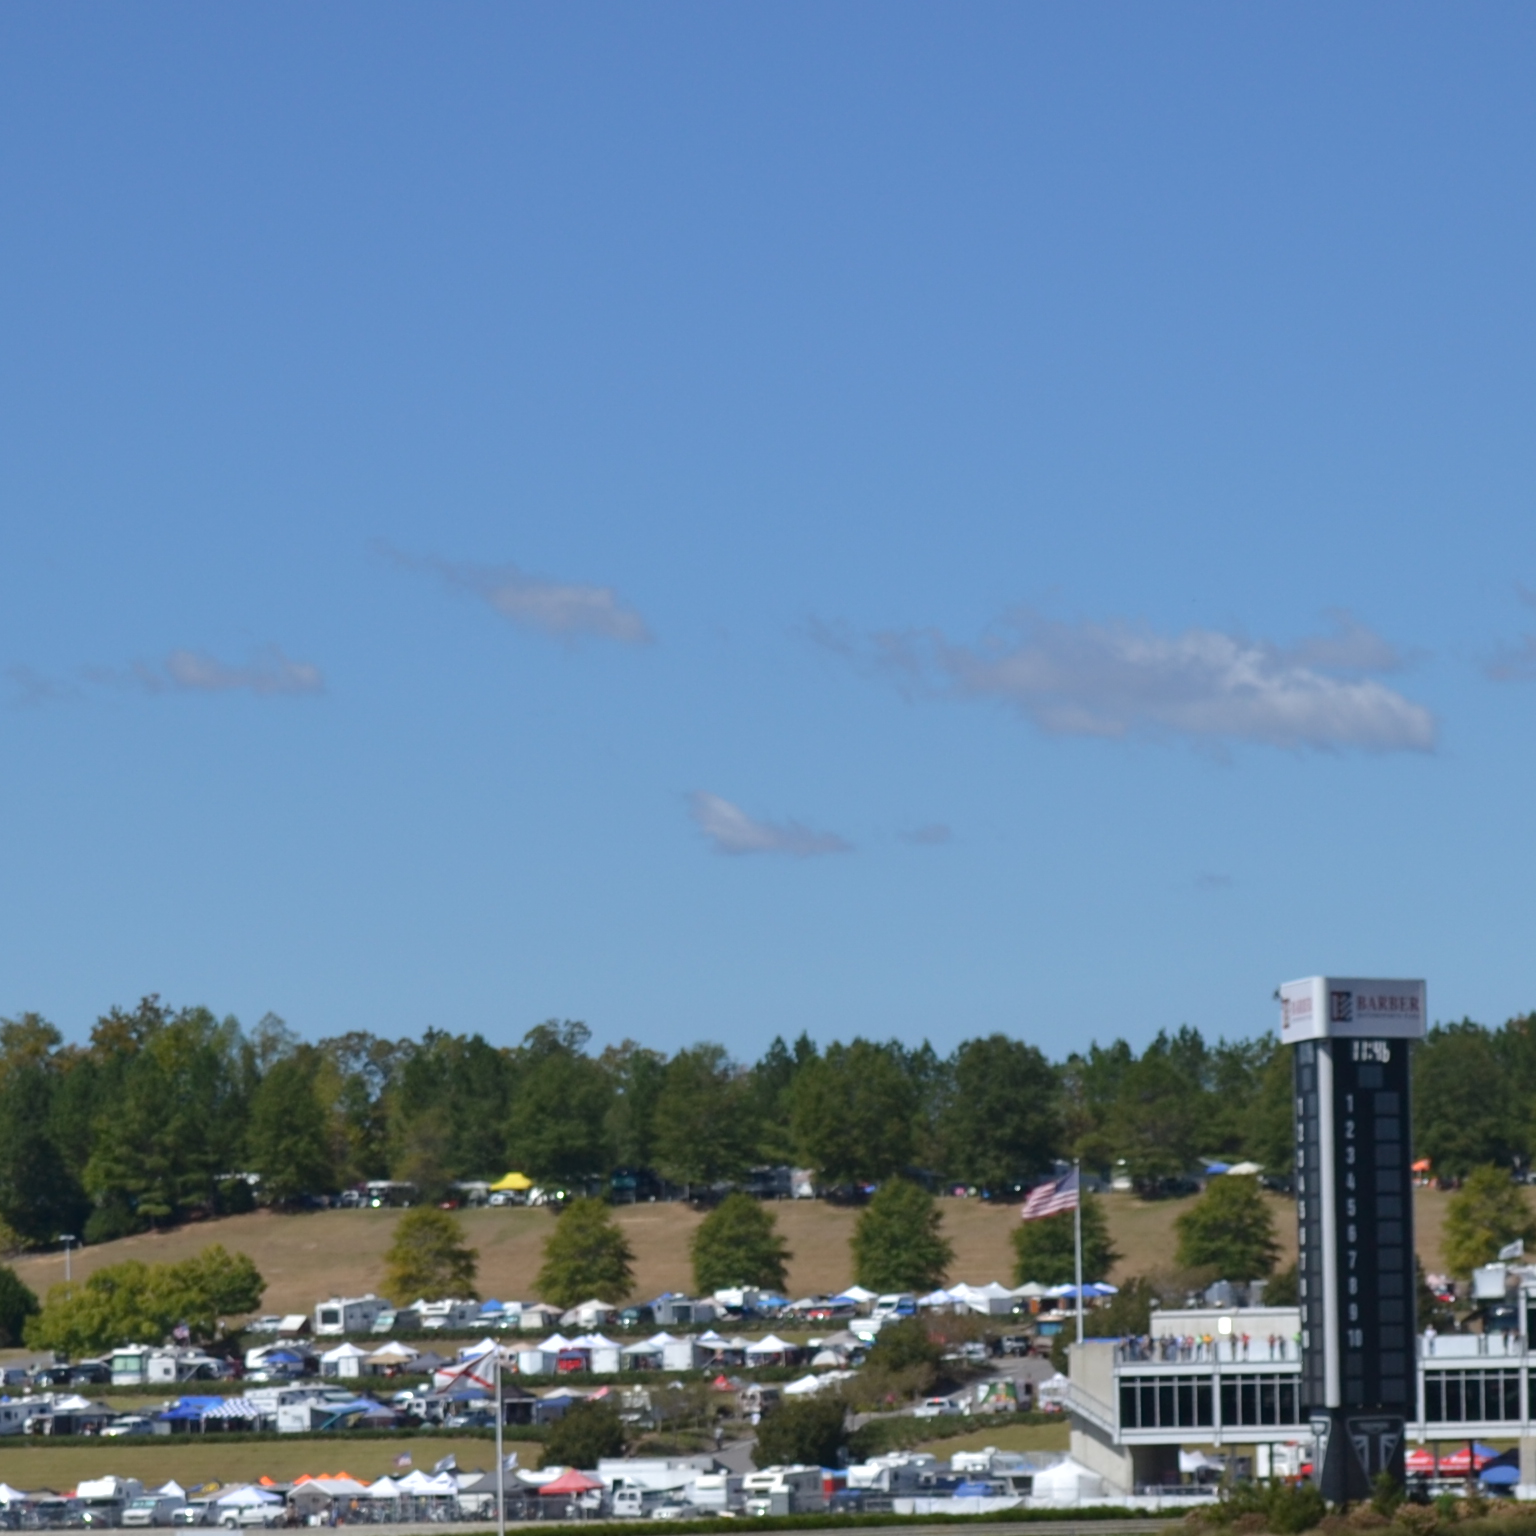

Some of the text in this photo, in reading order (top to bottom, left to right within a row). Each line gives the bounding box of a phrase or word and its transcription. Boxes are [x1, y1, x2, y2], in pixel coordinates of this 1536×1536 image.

[1356, 995, 1420, 1012] BARBER
[1345, 1120, 1355, 1139] 2
[1346, 1146, 1355, 1165] 3
[1346, 1172, 1356, 1191] 4
[1347, 1198, 1356, 1217] 5
[1348, 1250, 1357, 1269] 7
